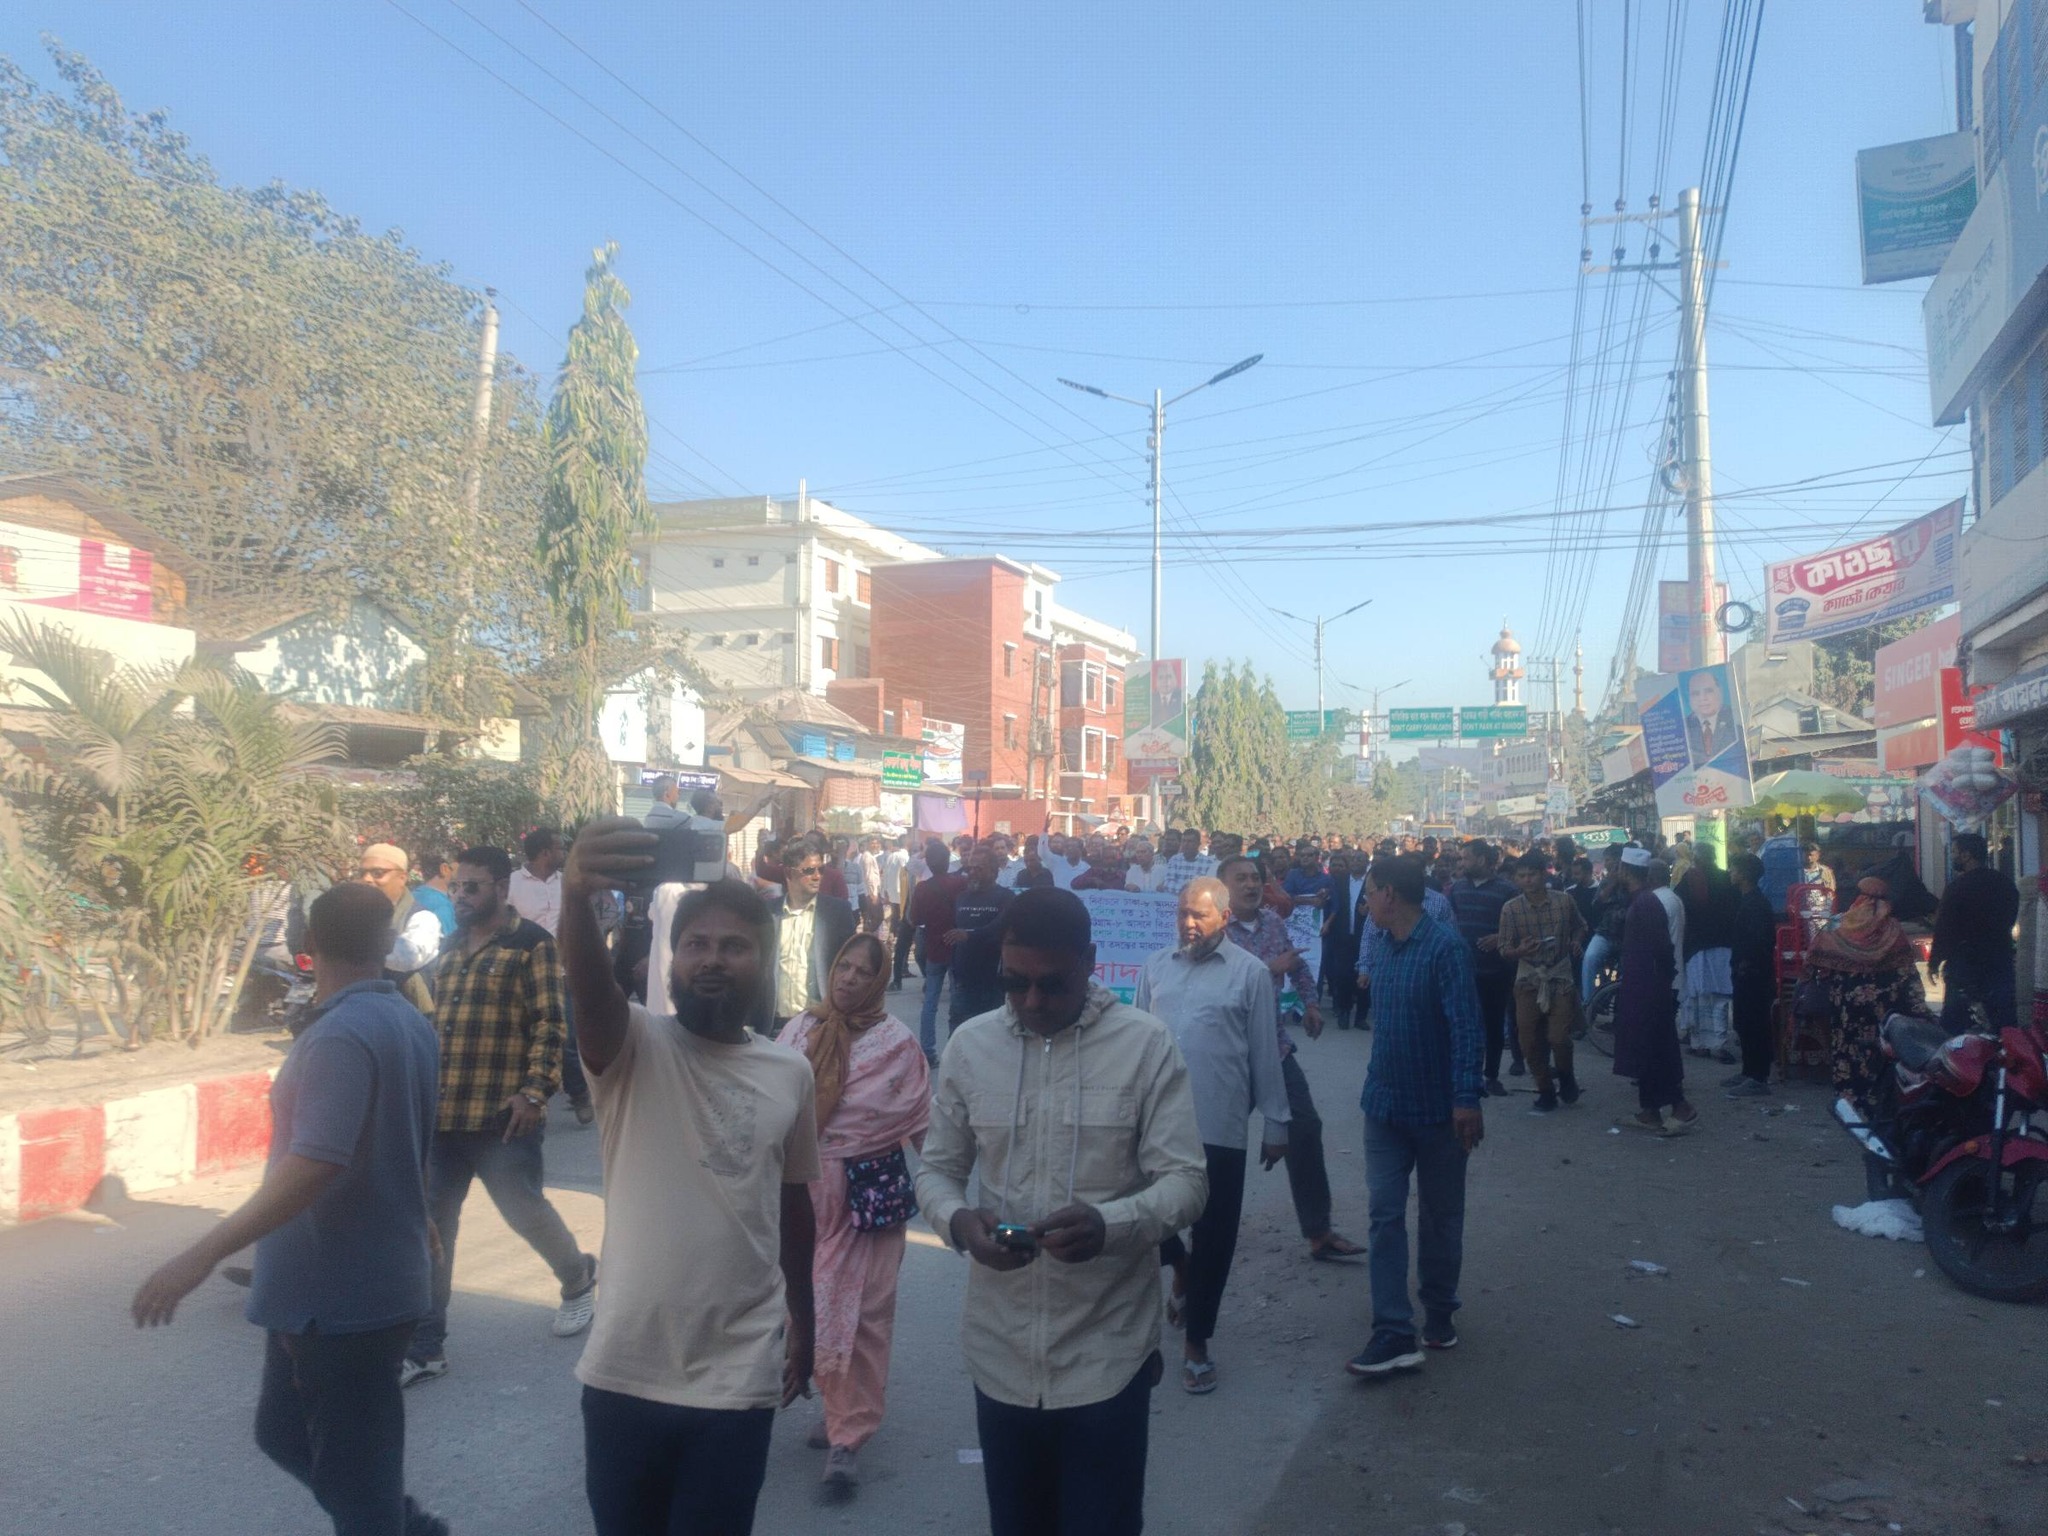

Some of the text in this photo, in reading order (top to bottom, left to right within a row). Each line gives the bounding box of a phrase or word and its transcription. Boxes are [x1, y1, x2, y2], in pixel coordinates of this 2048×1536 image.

[1803, 523, 1921, 588] কাওছার
[1884, 652, 1932, 691] SINGER
[1407, 724, 1422, 732] CARRY
[1479, 722, 1492, 731] PARK
